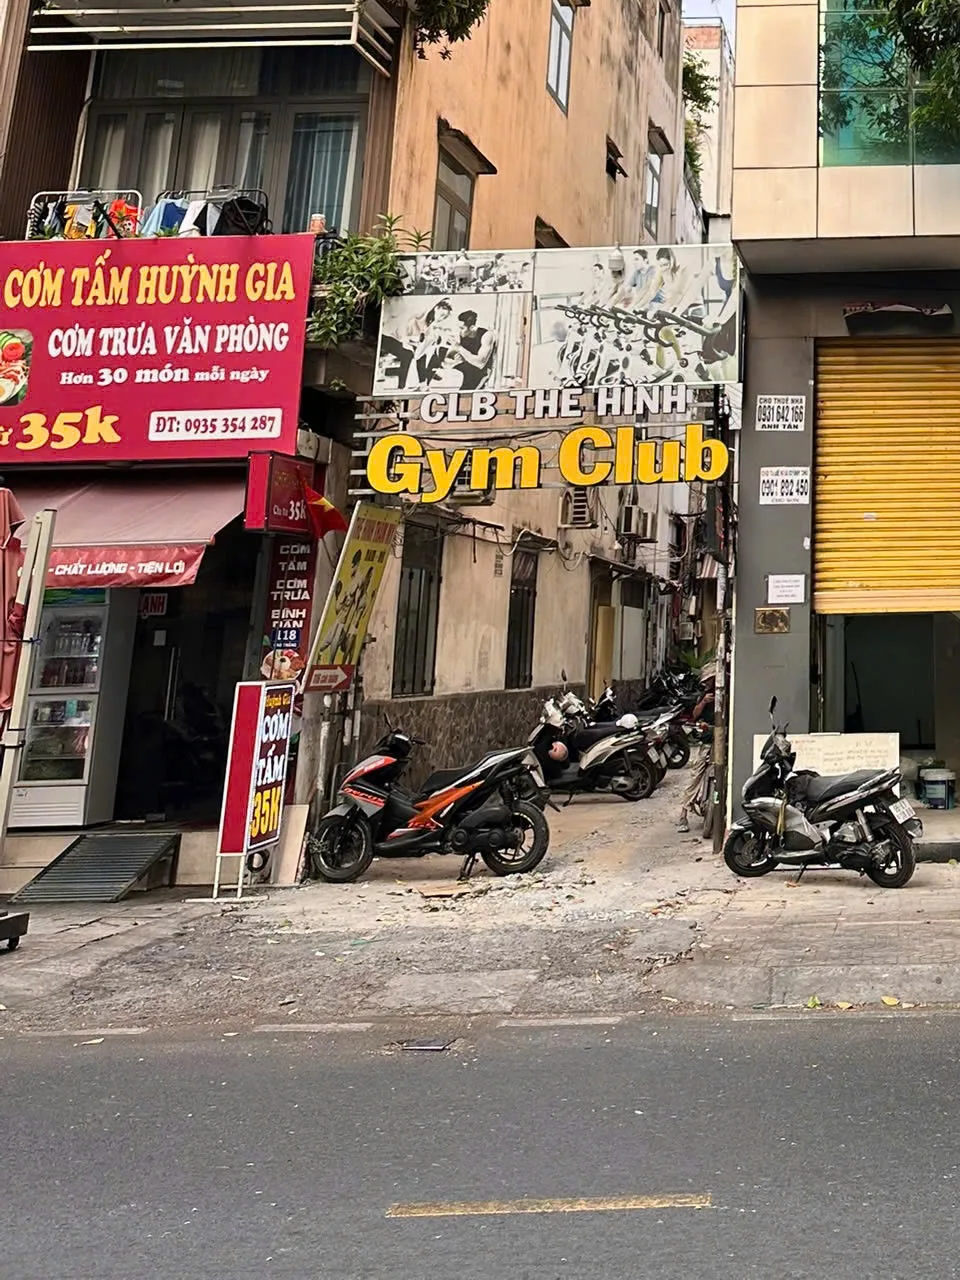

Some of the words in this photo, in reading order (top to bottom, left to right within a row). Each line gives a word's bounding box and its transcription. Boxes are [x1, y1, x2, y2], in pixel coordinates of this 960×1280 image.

[4, 261, 66, 308] CƠM
[71, 248, 132, 306] TẤM
[136, 254, 241, 304] HUỲNH
[245, 261, 296, 303] GIA
[48, 323, 95, 358] CƠM
[99, 322, 157, 356] TRƯA
[163, 316, 212, 355] VĂN
[214, 315, 290, 353] PHÒNG
[59, 371, 94, 386] Hơn
[96, 367, 128, 387] 30
[134, 363, 190, 384] món
[193, 364, 226, 382] mỗi
[229, 367, 270, 385] ngày
[420, 391, 497, 423] CLB
[757, 405, 775, 422] 0931
[776, 405, 789, 422] 642
[791, 405, 804, 422] 166
[15, 404, 122, 451] 35k
[155, 415, 182, 434] ĐT:
[184, 415, 218, 435] 0935
[220, 415, 247, 433] 354
[250, 414, 276, 432] 287
[366, 433, 541, 505] Gym
[558, 422, 730, 488] Club
[795, 479, 809, 497] 450
[280, 543, 311, 555] CƠM
[54, 558, 87, 575] CHẤT
[87, 561, 128, 576] LƯỢNG
[165, 560, 186, 576] LỢI
[270, 589, 311, 601] TRƯA
[262, 708, 290, 743] CƠM
[256, 743, 285, 787] TẤM
